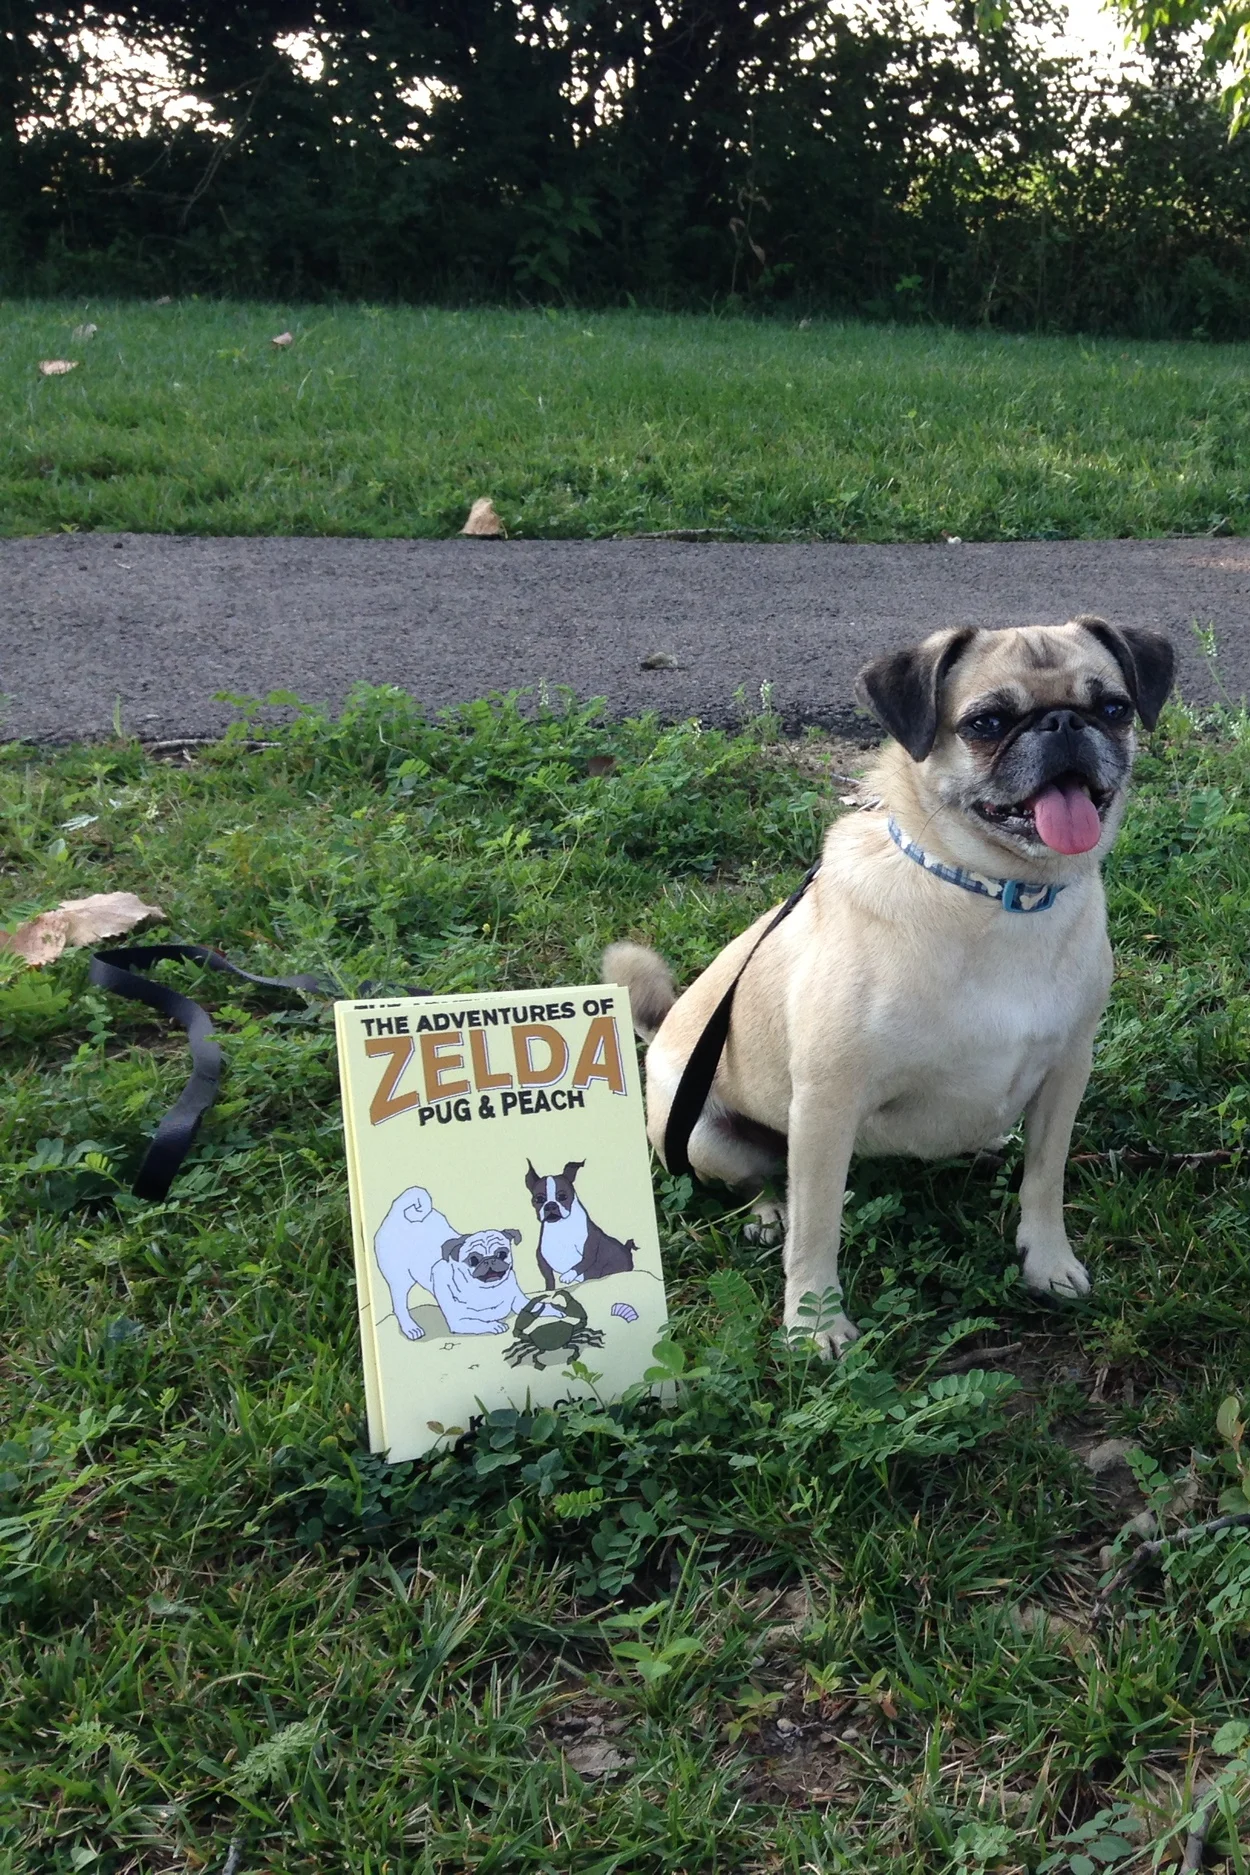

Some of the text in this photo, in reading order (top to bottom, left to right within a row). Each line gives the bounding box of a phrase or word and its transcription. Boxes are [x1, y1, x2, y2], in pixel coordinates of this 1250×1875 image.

[361, 1015, 409, 1037] THE
[416, 1001, 576, 1033] ADVENTURES
[582, 998, 614, 1016] OF
[364, 1016, 627, 1126] ZELDA
[418, 1090, 585, 1126] PUG & PEACH
